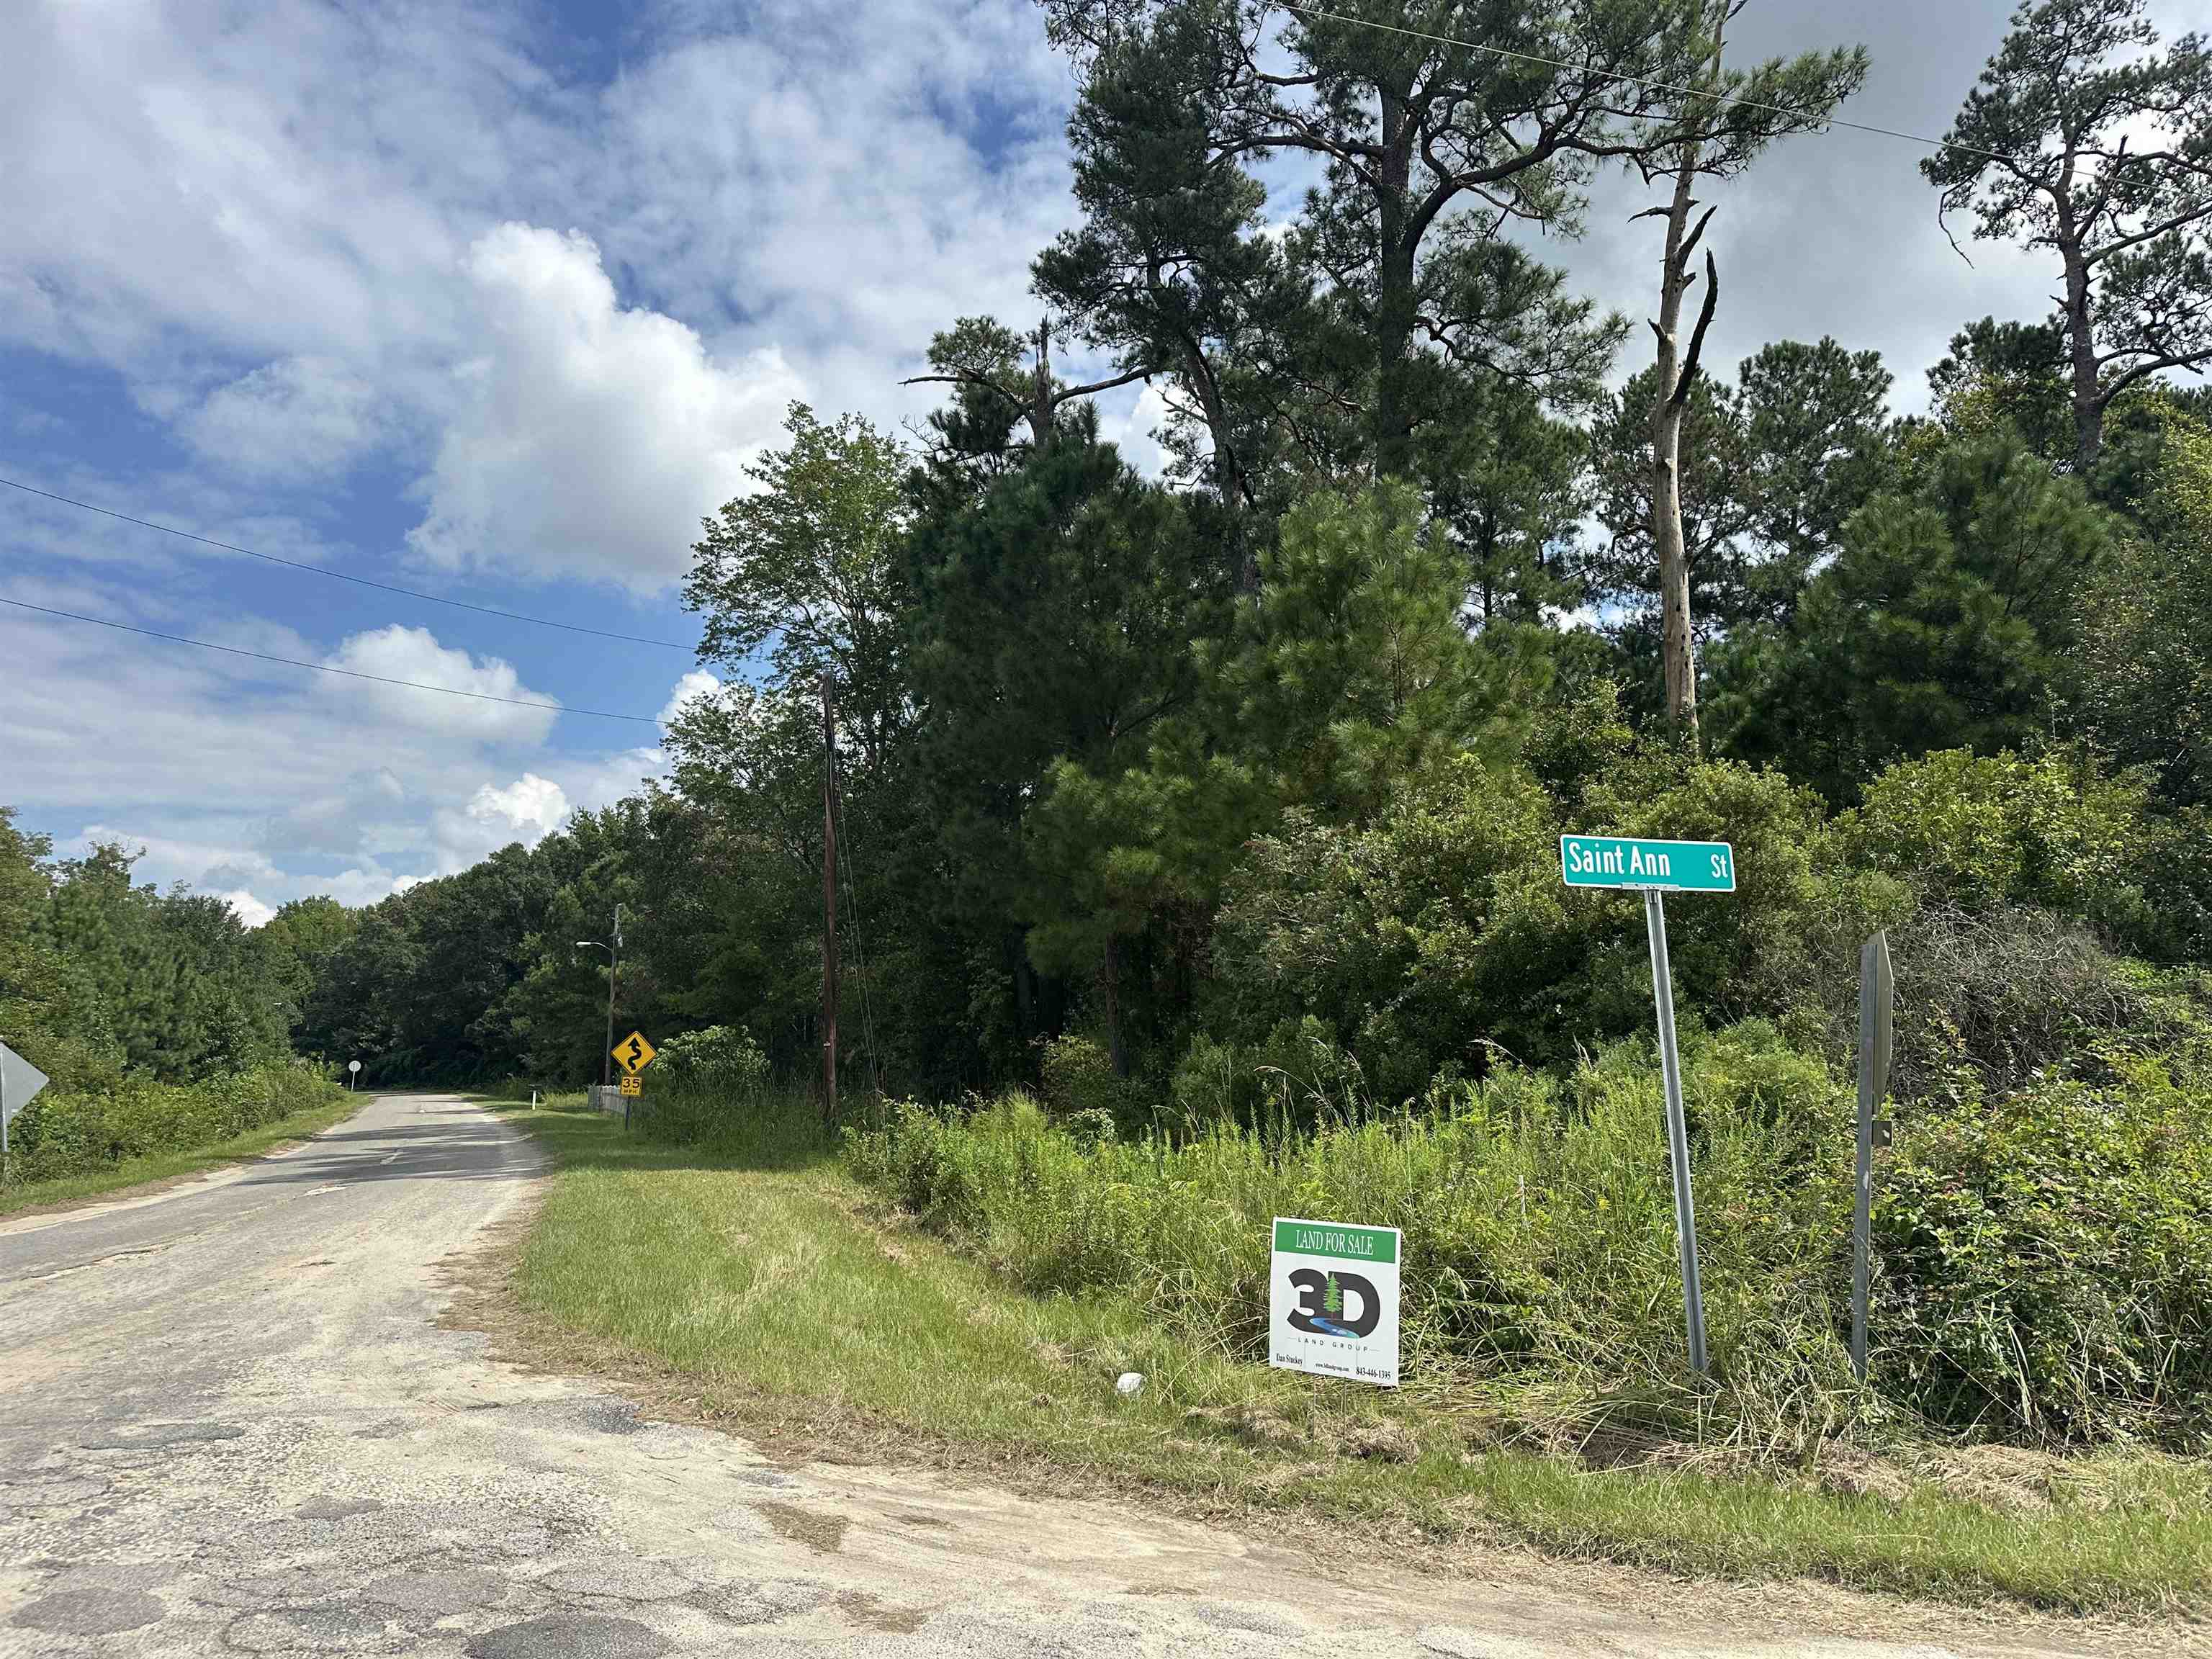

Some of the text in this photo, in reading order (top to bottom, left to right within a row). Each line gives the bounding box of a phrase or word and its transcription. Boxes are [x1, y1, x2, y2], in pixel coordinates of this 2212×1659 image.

[1569, 842, 1728, 878] Saint Ann St
[623, 1078, 640, 1088] 35
[1296, 1229, 1374, 1256] LAND FOR SALE
[1287, 1268, 1380, 1339] 3D
[1298, 1337, 1368, 1352] LAND GROUP
[1356, 1367, 1391, 1380] 843-446-1395
